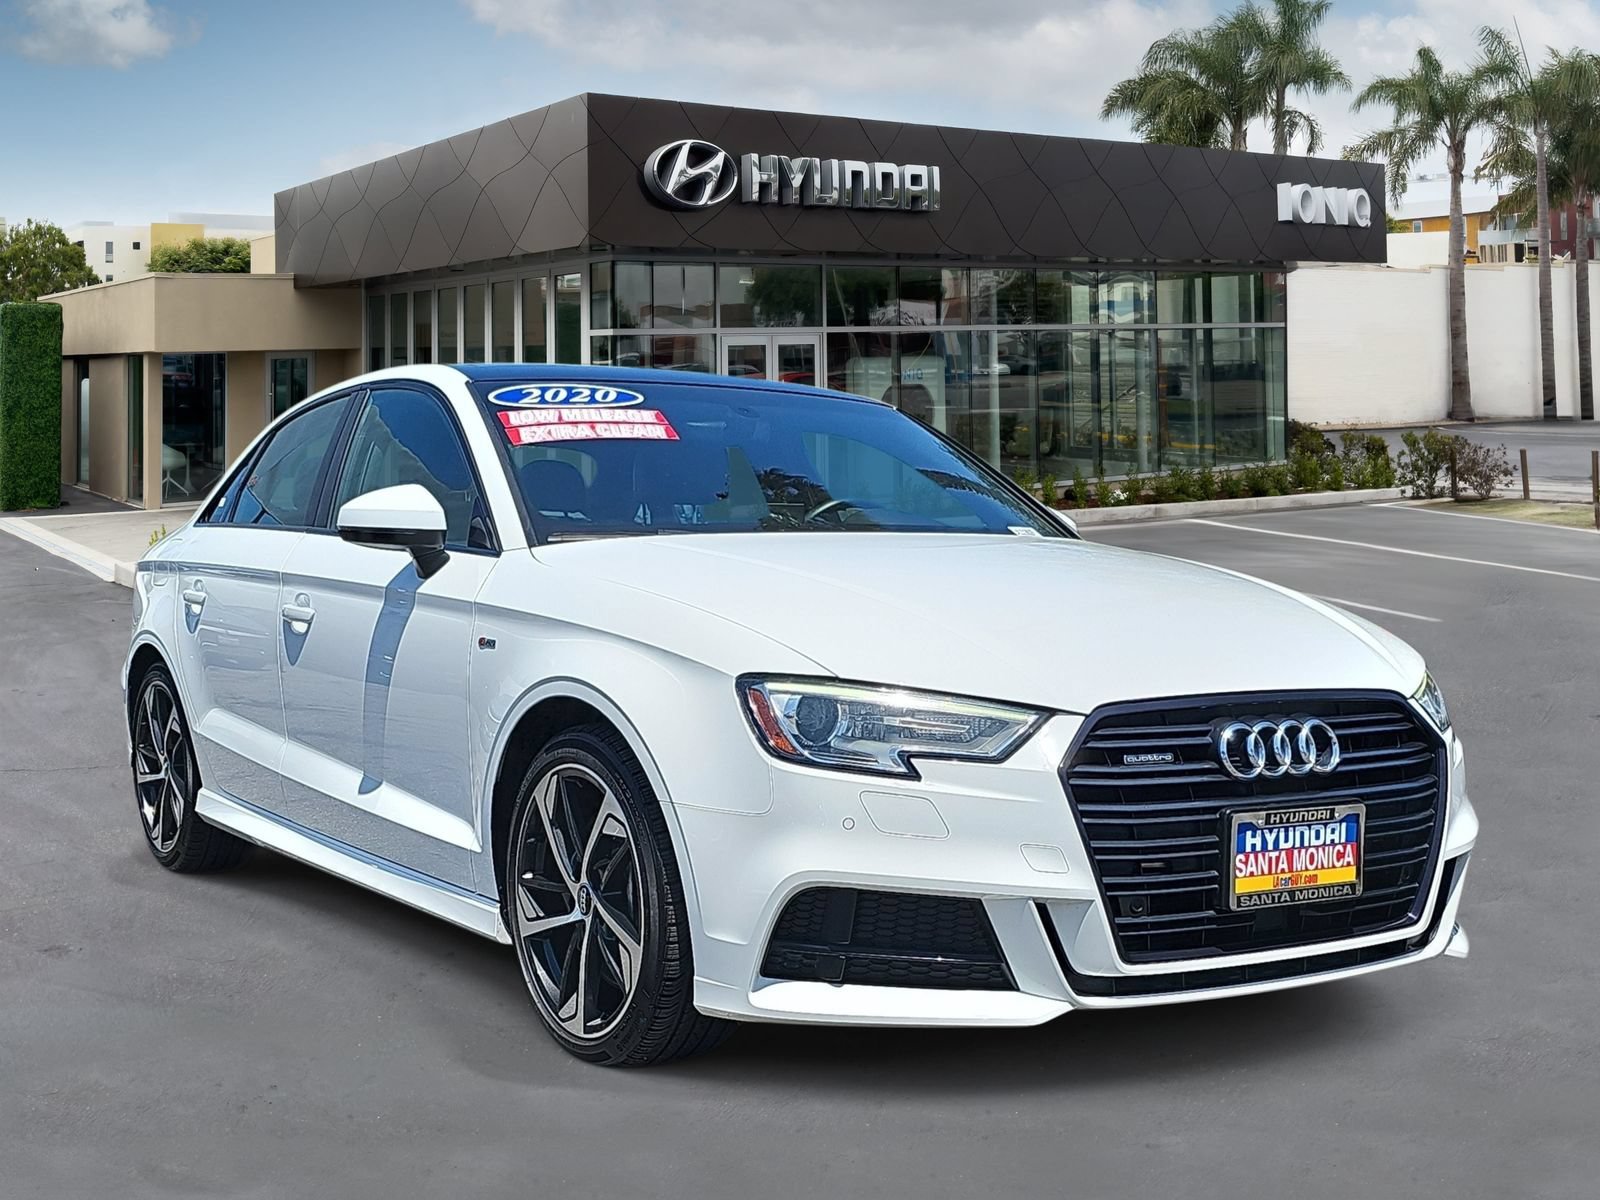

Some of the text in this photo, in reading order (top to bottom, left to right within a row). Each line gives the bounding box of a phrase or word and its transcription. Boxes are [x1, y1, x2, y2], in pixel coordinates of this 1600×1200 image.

[741, 153, 940, 212] HYUNDAI
[1277, 182, 1371, 227] IONIQ
[518, 387, 618, 404] 2020
[1127, 754, 1172, 763] quattro
[1270, 809, 1330, 824] HYUNDAI
[1245, 822, 1347, 853] HYUNDAI
[1235, 844, 1354, 878] SANTA MONICA
[1240, 885, 1352, 907] SANTA MONICA
